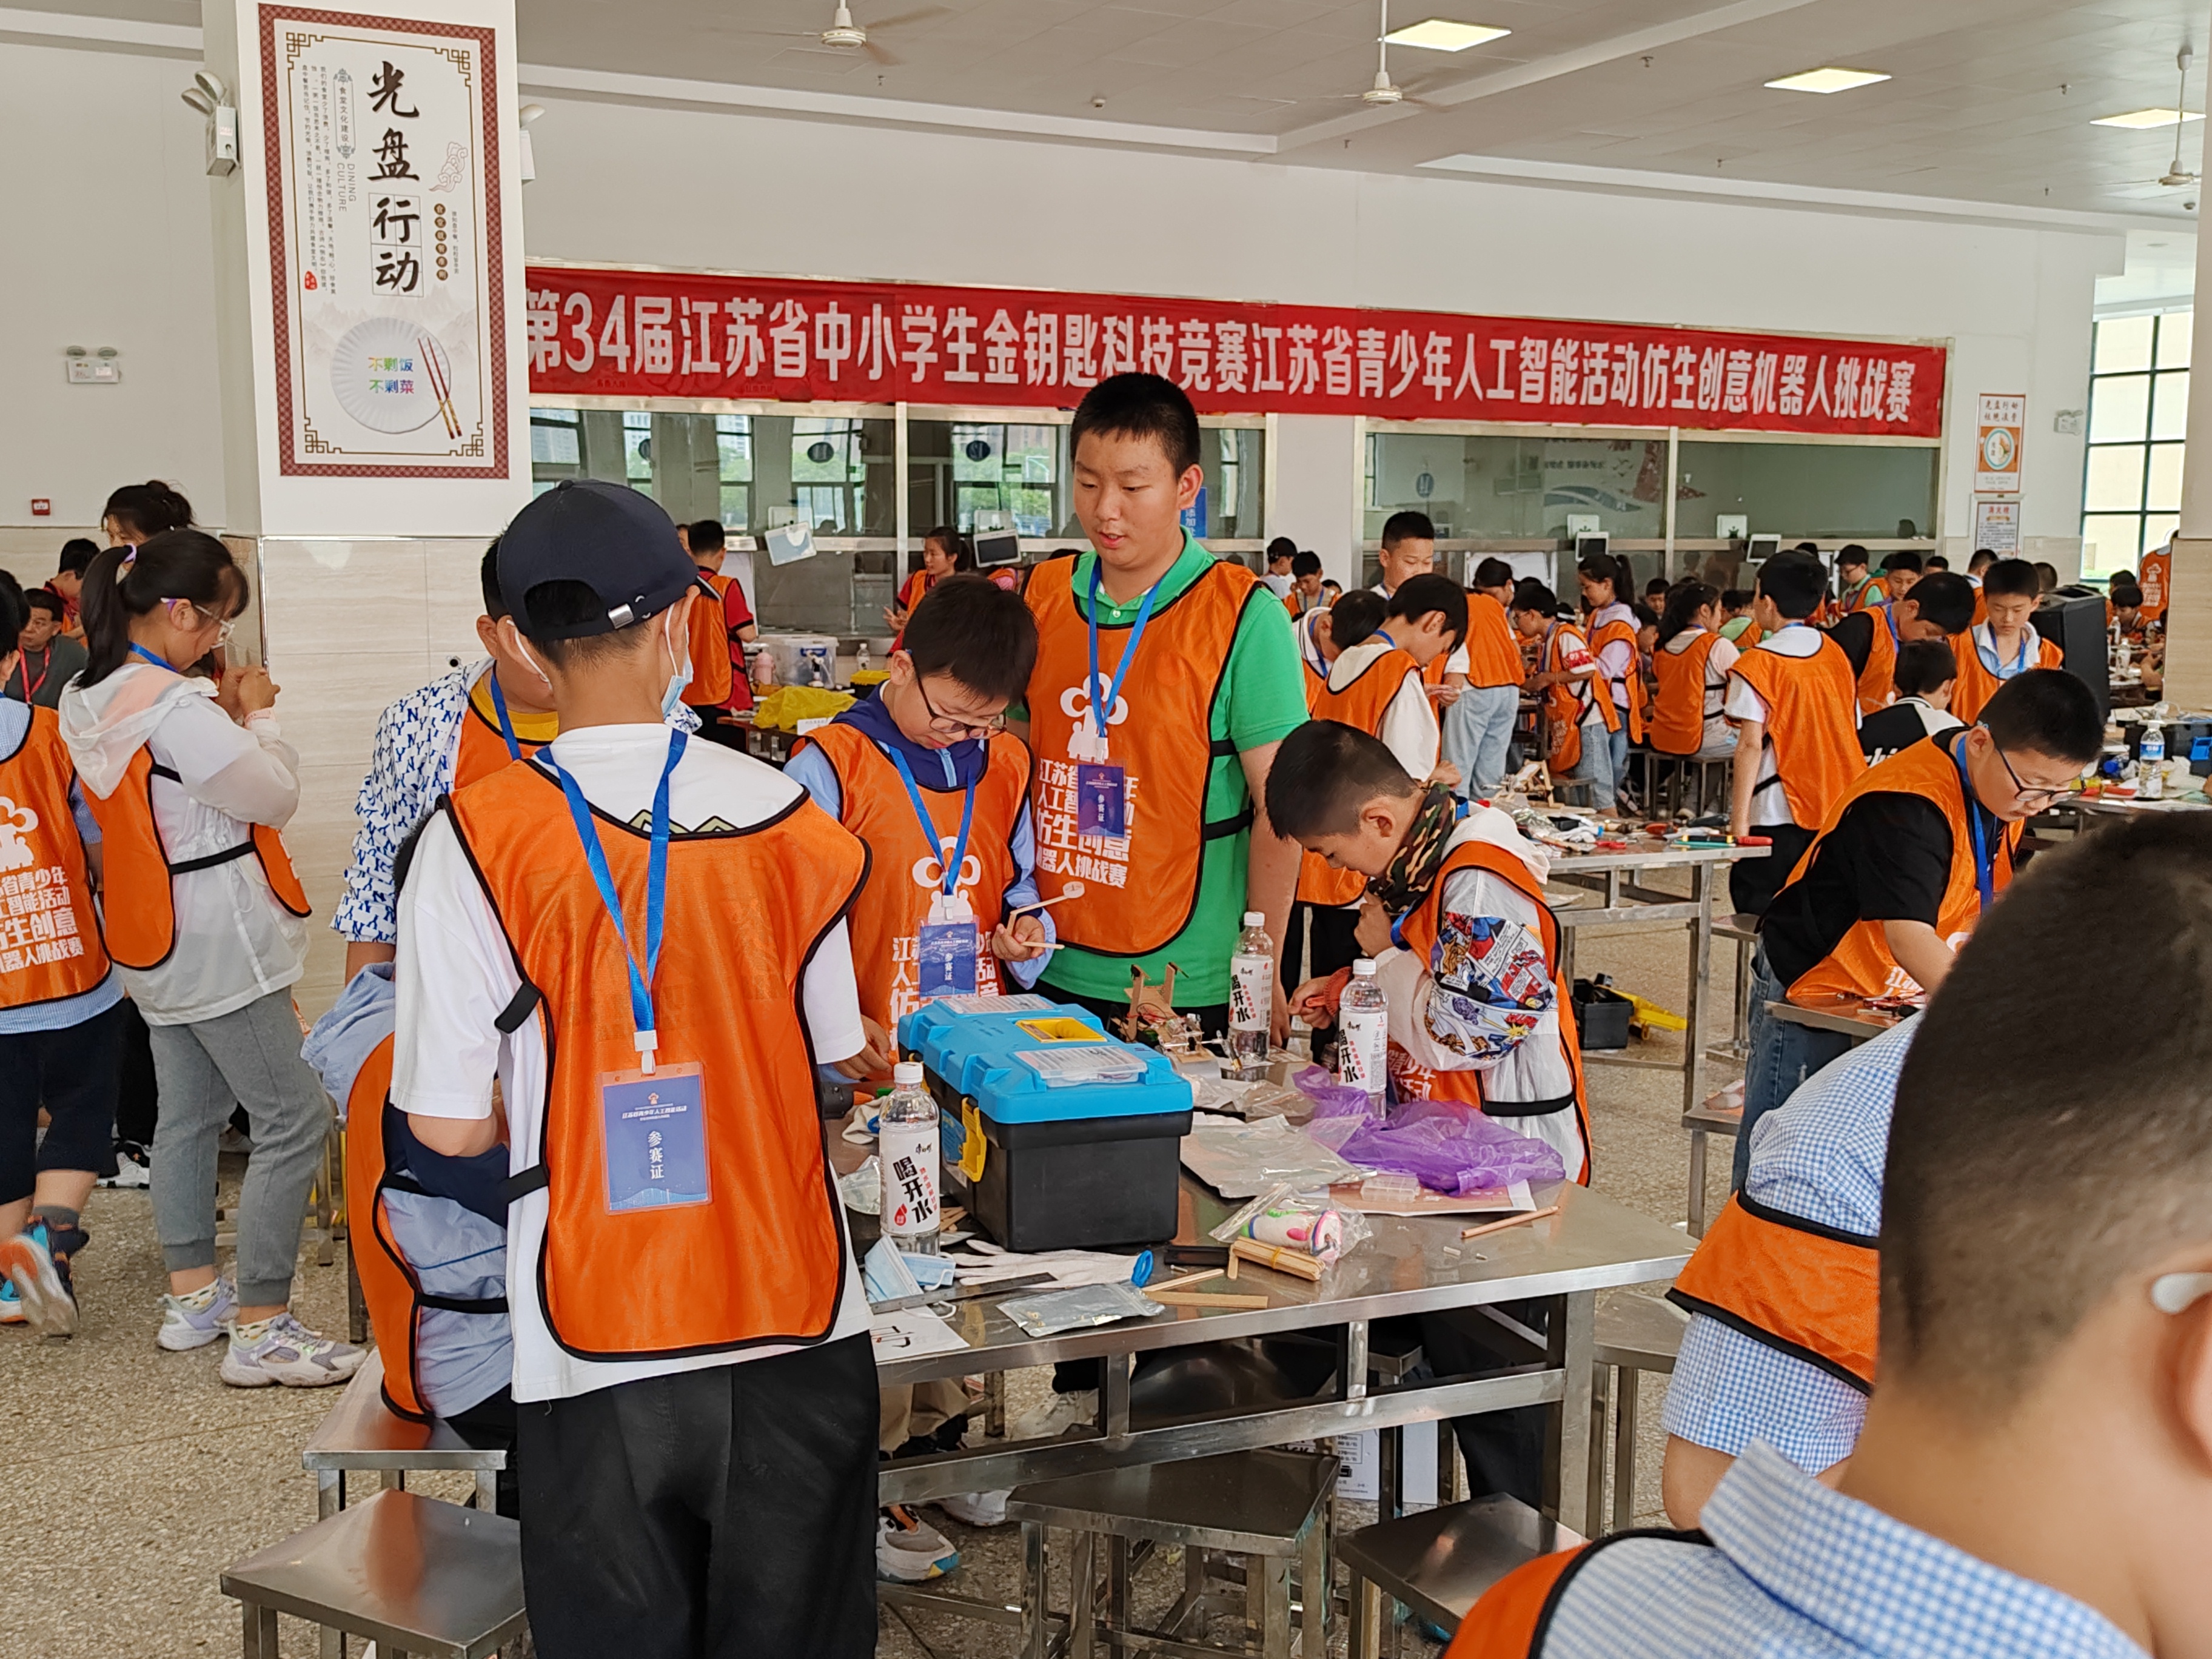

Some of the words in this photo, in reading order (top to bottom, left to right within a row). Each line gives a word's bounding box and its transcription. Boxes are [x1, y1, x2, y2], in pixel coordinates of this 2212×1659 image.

[339, 87, 350, 143] 食堂文化建设
[337, 163, 347, 212] CULTURE
[347, 163, 357, 202] DINING
[367, 61, 420, 292] 光盘行动
[368, 357, 414, 372] 不剩饭
[369, 379, 414, 394] 不剩菜
[1039, 758, 1139, 800] 江苏省年
[0, 866, 68, 896] 省青少年
[0, 936, 84, 973] 器人挑战赛
[648, 1130, 665, 1179] 参赛证
[893, 1156, 934, 1224] 喝开水
